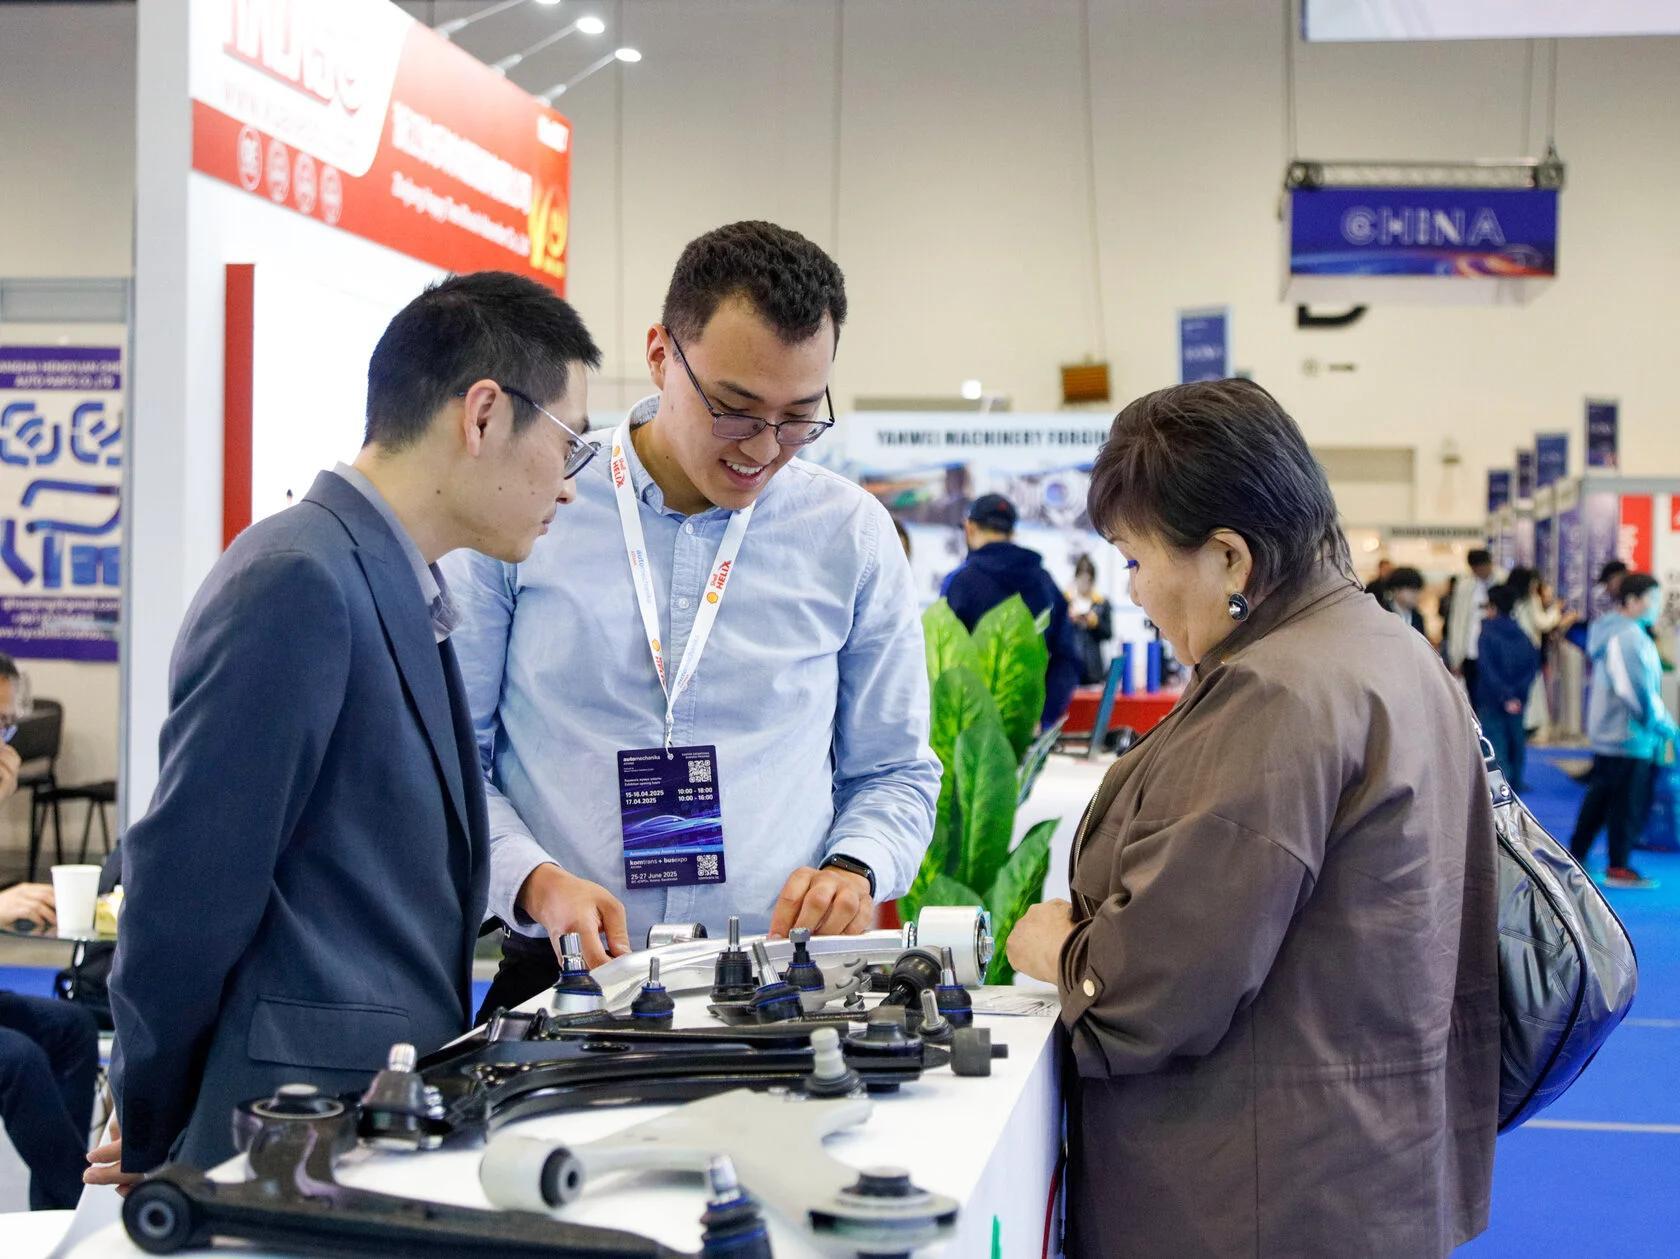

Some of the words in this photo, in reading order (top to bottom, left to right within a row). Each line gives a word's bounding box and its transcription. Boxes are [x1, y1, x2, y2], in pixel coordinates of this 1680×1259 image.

[1341, 205, 1507, 246] CHINA
[945, 430, 1042, 446] MACHINERY
[612, 460, 625, 489] HELIX
[716, 559, 732, 589] HELIX
[623, 755, 661, 763] automechanika
[663, 870, 678, 878] 2025
